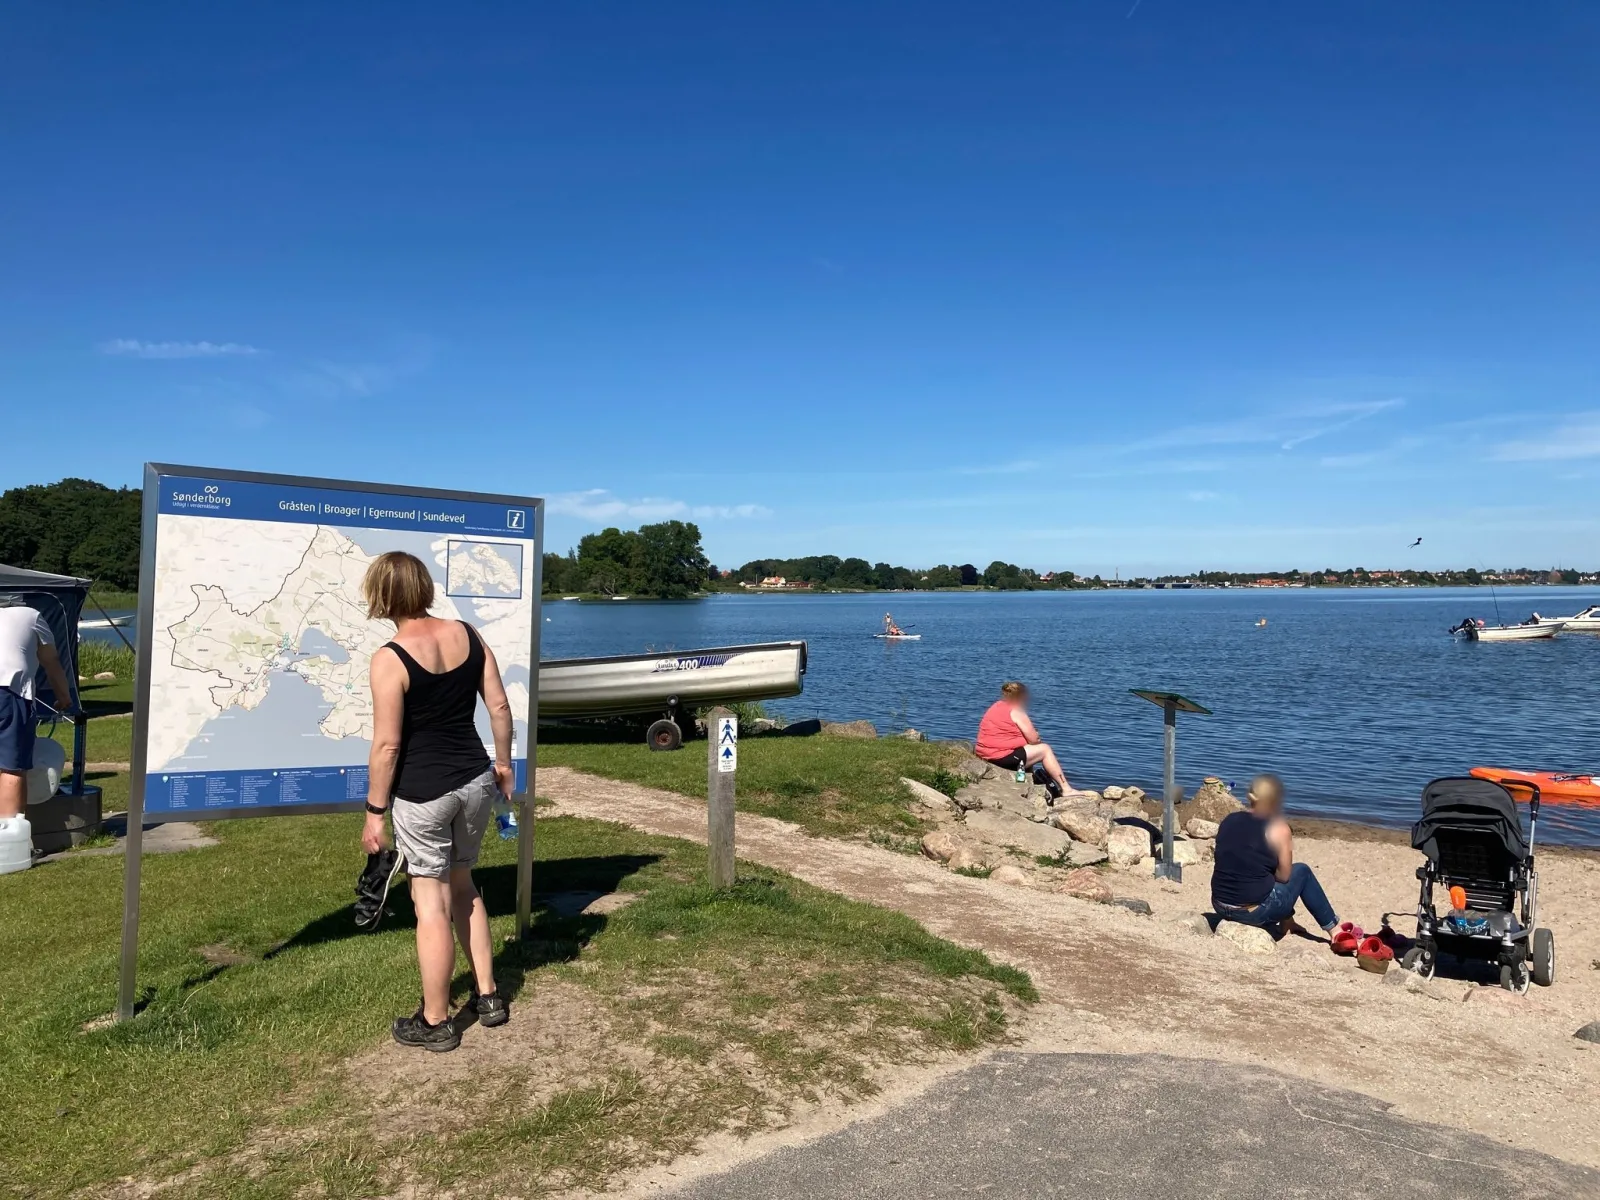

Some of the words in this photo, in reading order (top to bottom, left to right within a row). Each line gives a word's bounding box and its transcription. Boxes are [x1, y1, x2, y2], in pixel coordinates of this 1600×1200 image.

[172, 491, 231, 507] Sønderborg
[279, 500, 316, 512] Gråsten
[324, 504, 361, 517] Broager
[369, 507, 415, 519] Egernsund
[423, 511, 465, 523] Sundeved
[679, 659, 698, 670] 400
